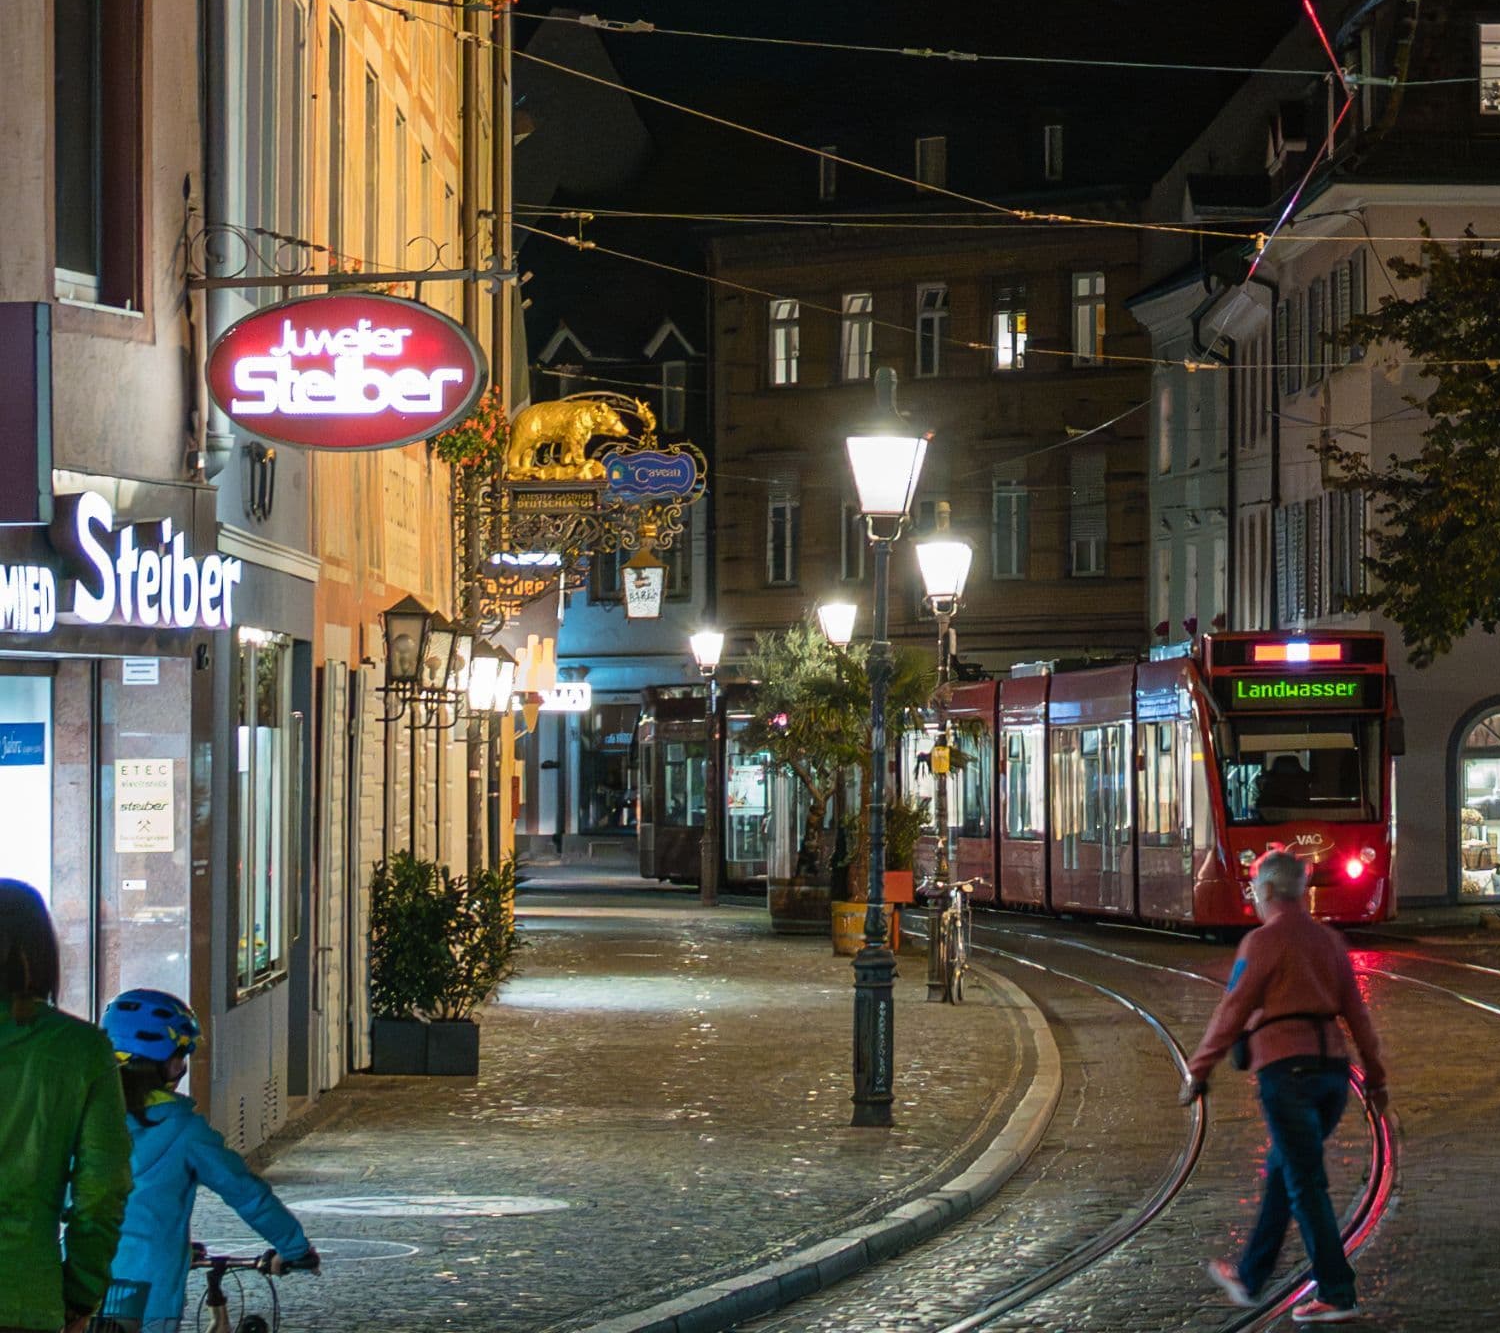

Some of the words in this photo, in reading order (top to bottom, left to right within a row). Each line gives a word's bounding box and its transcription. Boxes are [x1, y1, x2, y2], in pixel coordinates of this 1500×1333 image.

[231, 356, 463, 415] Steiber
[74, 490, 242, 629] Steiber
[1237, 681, 1357, 698] Landwasser
[1296, 833, 1323, 845] VAG
